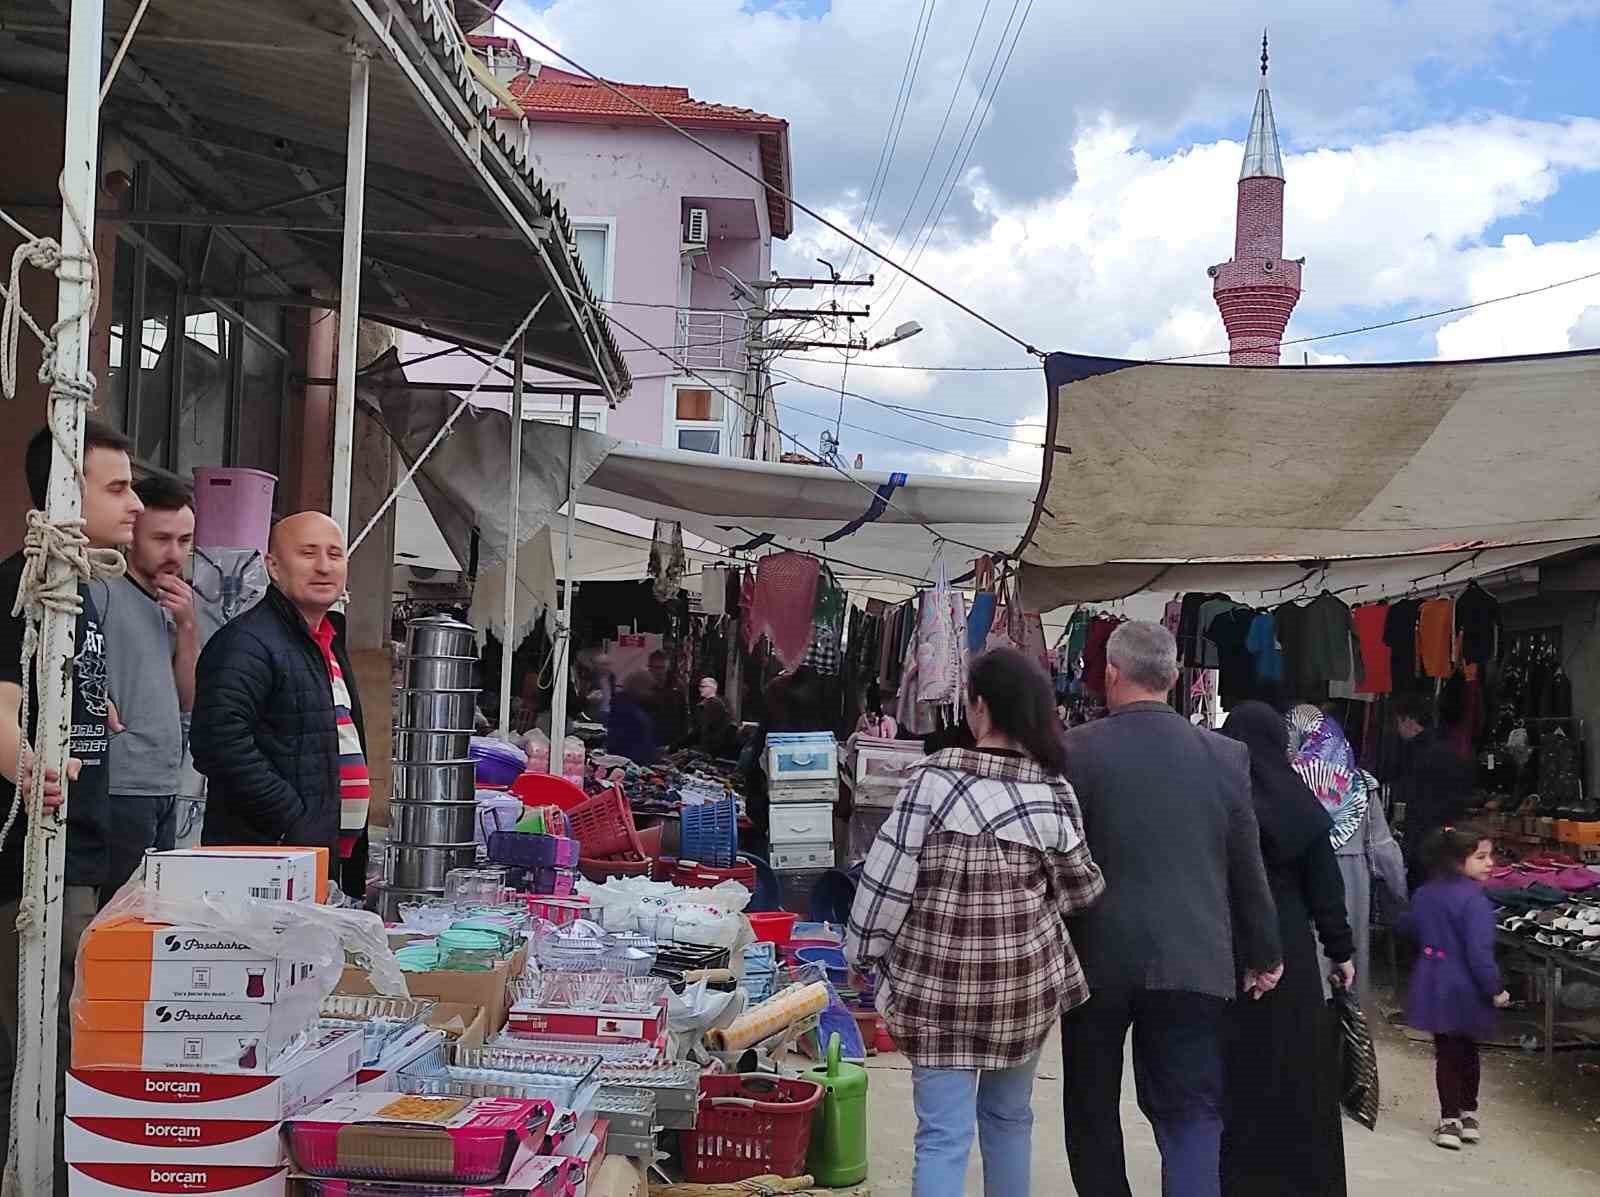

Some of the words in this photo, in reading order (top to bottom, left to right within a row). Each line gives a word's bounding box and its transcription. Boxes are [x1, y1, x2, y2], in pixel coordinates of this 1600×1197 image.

[145, 1078, 201, 1093] borcam
[145, 1122, 201, 1137] borcam
[150, 1169, 207, 1184] borcam
